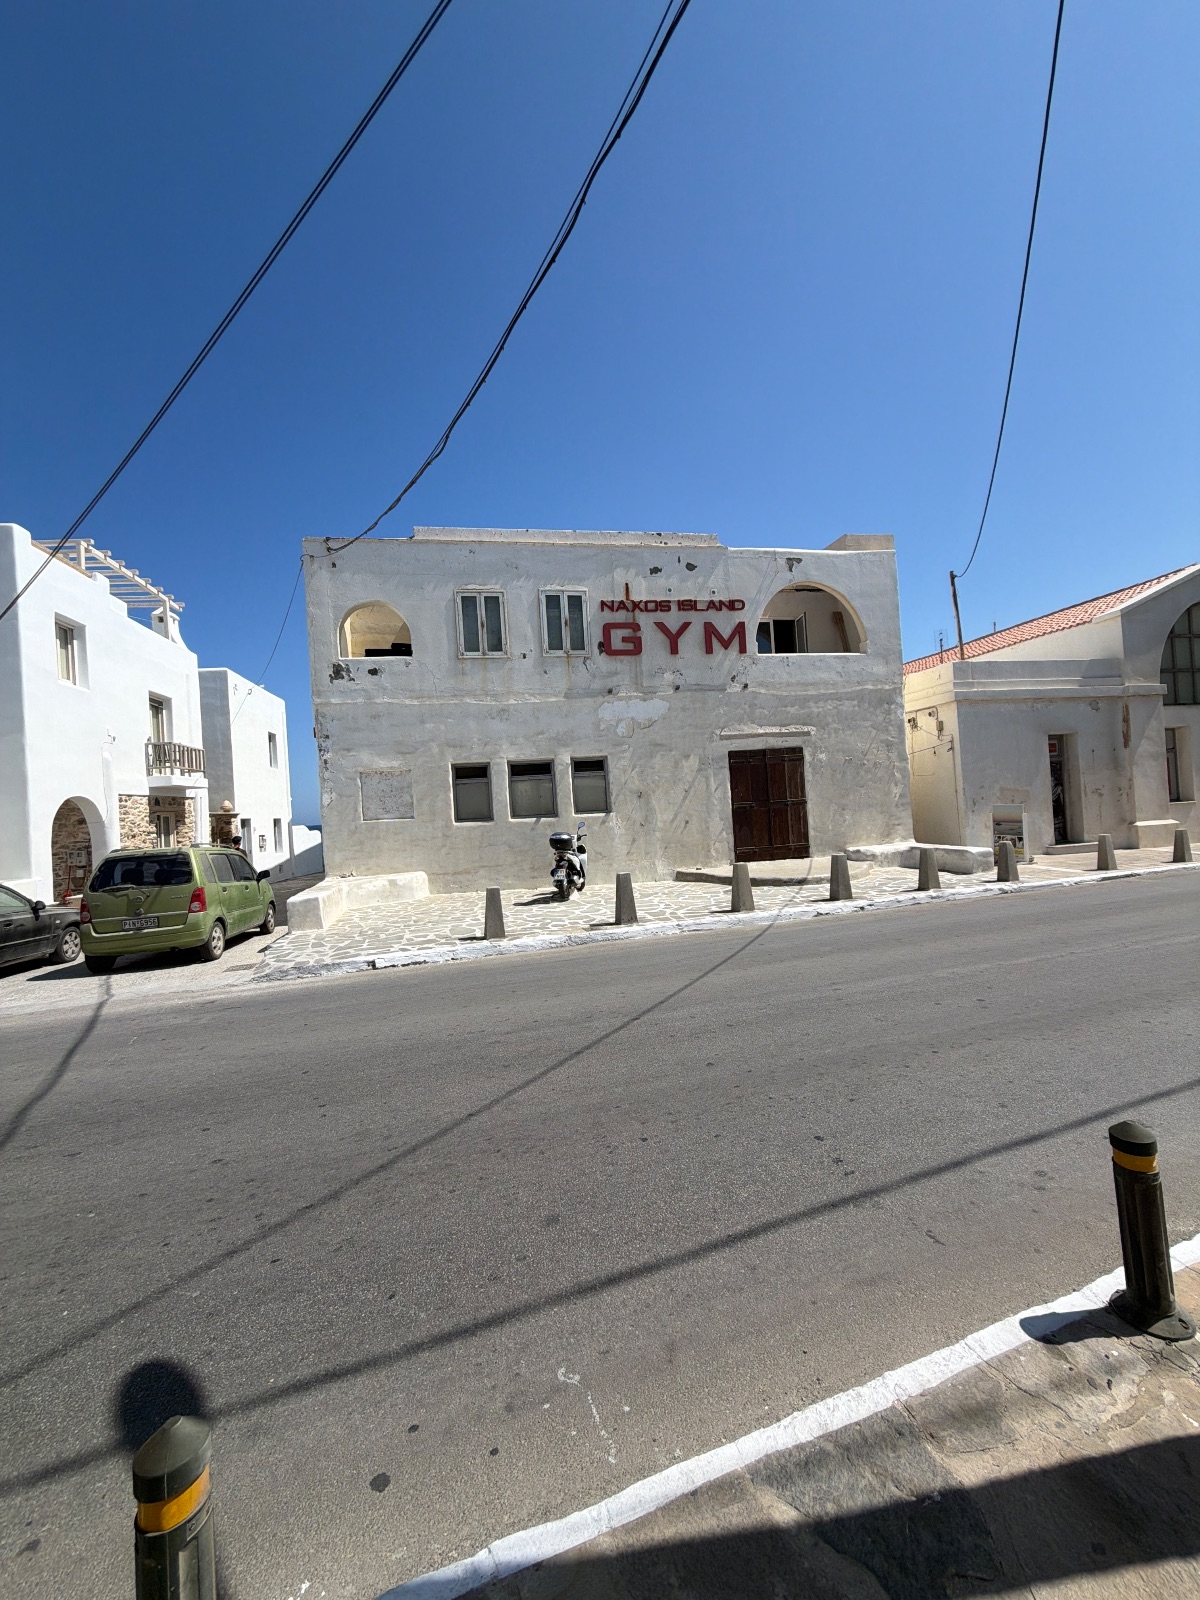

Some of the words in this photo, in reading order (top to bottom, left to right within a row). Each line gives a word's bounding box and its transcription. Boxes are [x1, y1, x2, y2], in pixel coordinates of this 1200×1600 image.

[600, 599, 672, 612] NAXOS
[677, 599, 746, 612] ISLAND
[602, 621, 747, 656] GYM
